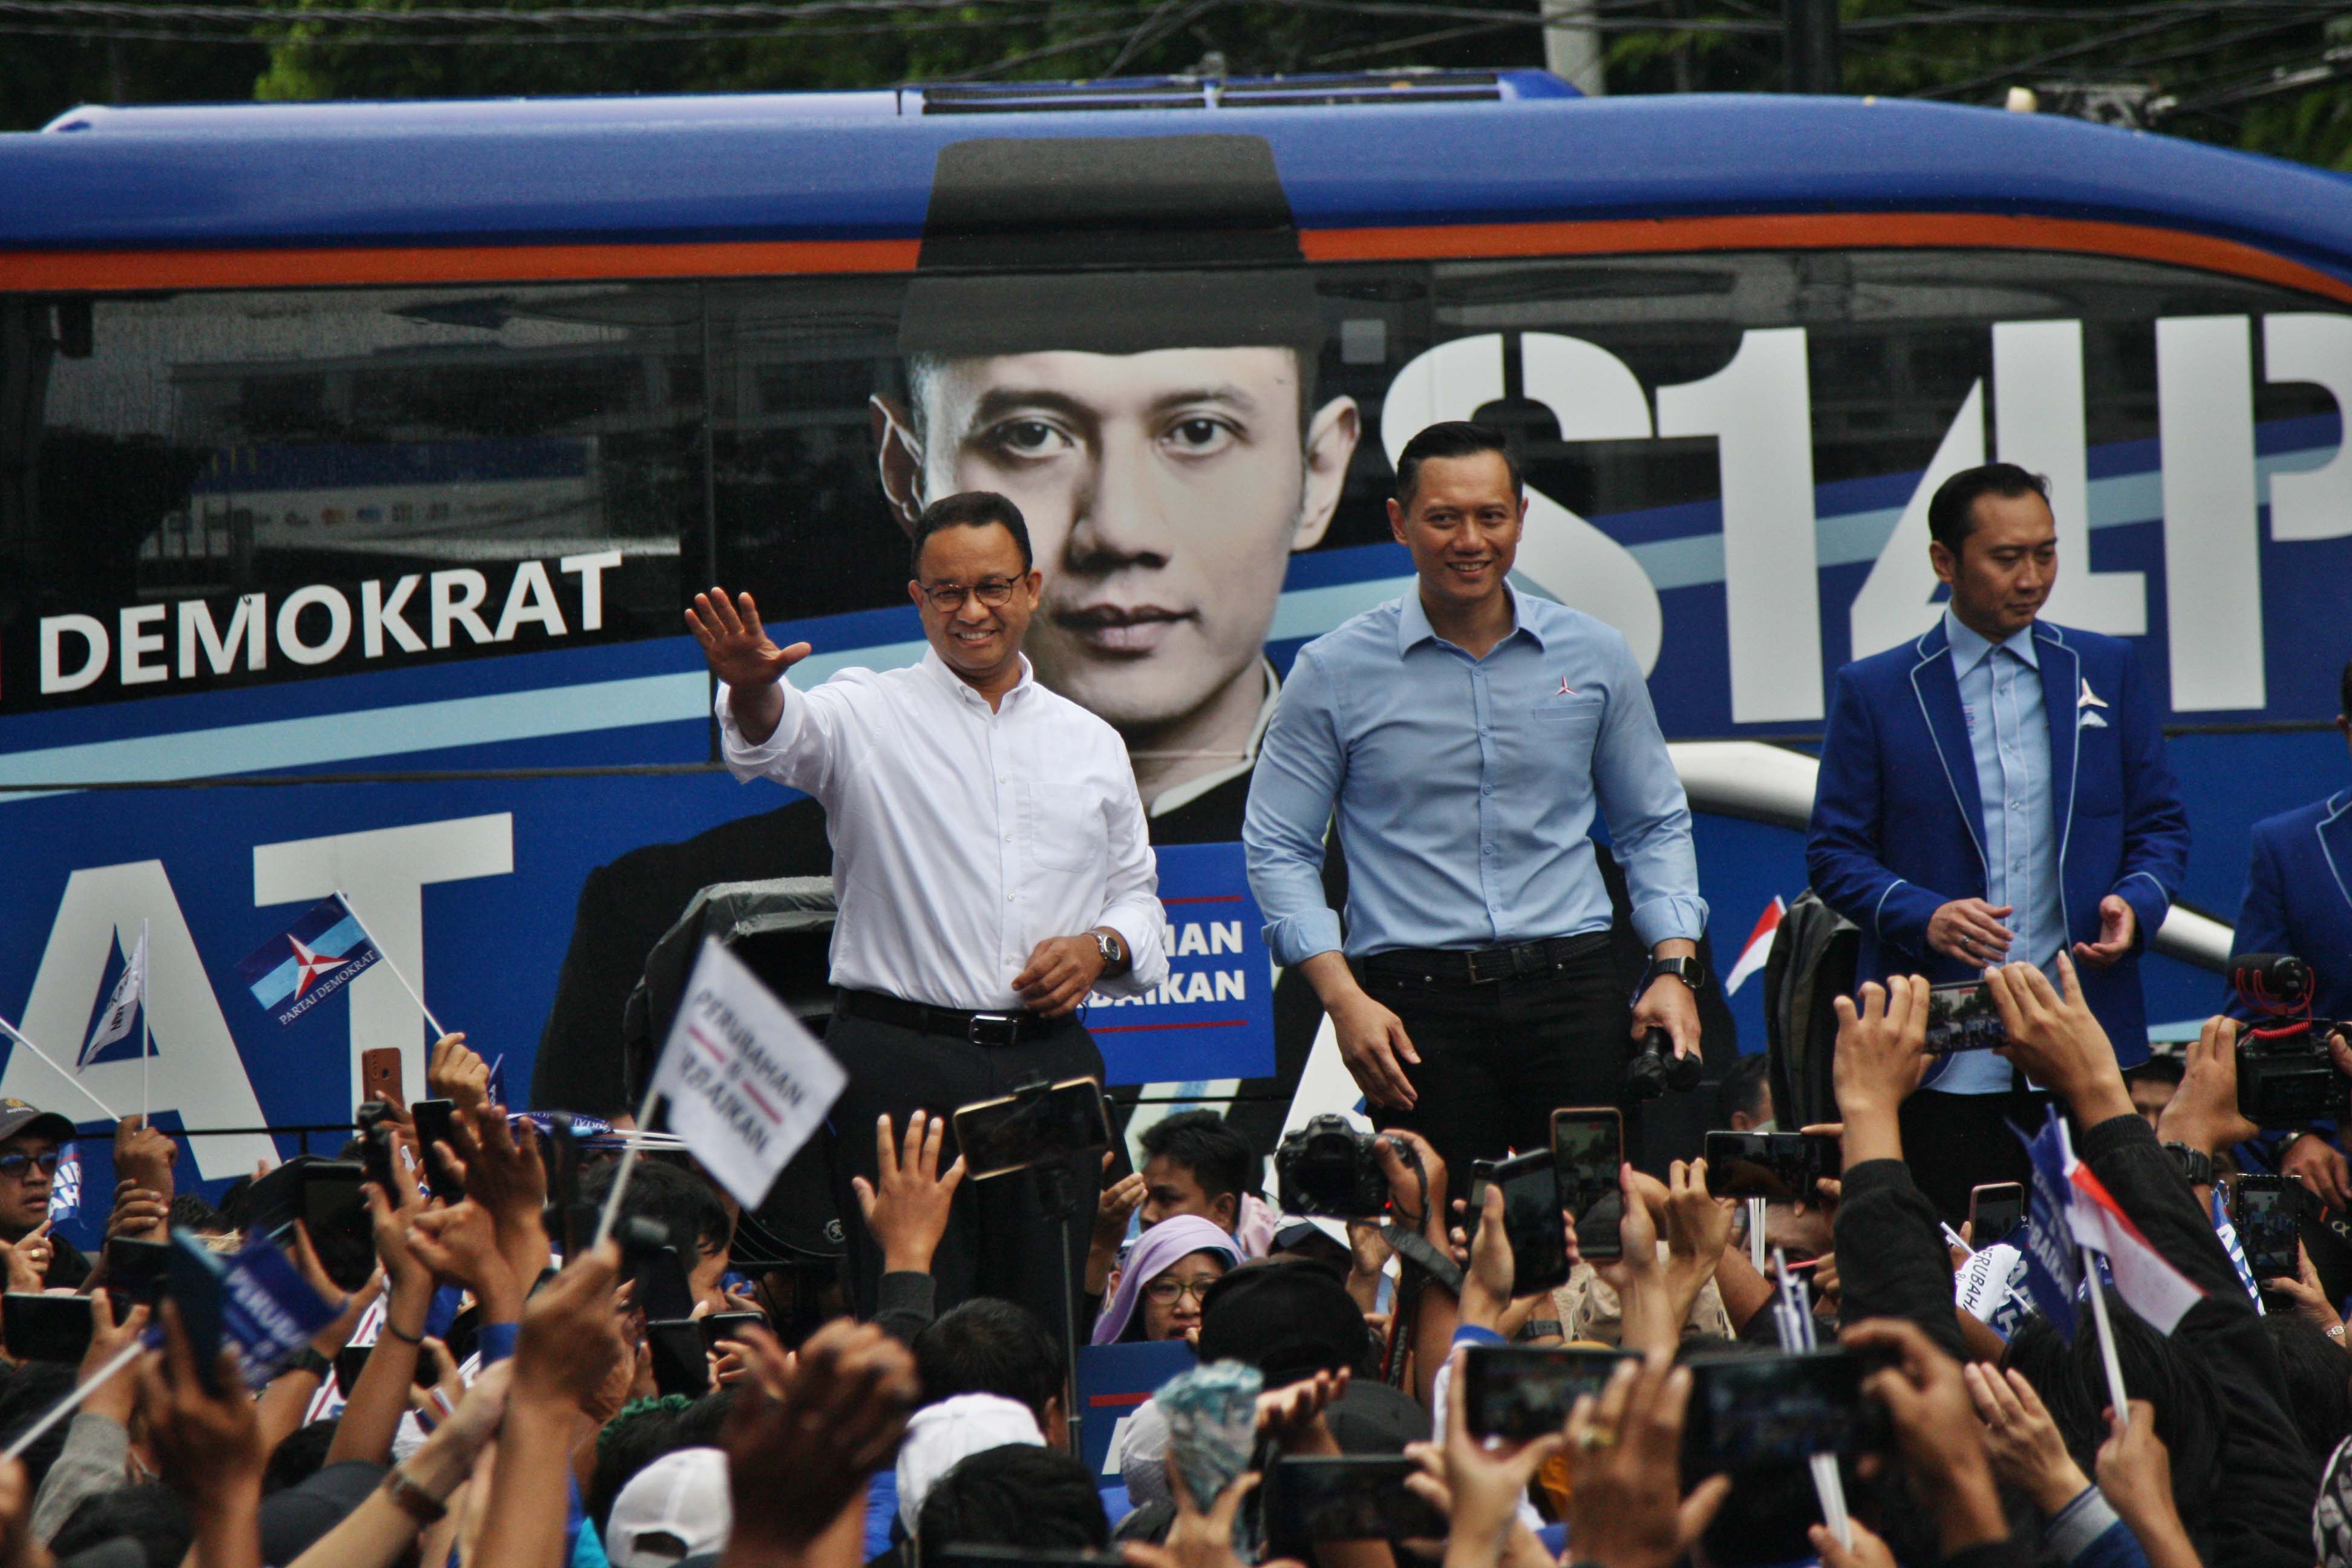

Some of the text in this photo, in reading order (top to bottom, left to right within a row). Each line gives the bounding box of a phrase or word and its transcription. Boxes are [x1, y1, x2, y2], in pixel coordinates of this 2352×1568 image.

[41, 550, 621, 694] DEMOKRAT
[279, 950, 376, 1025] PARTAI DEMOKRAT
[695, 988, 809, 1108] PERUBAHAN
